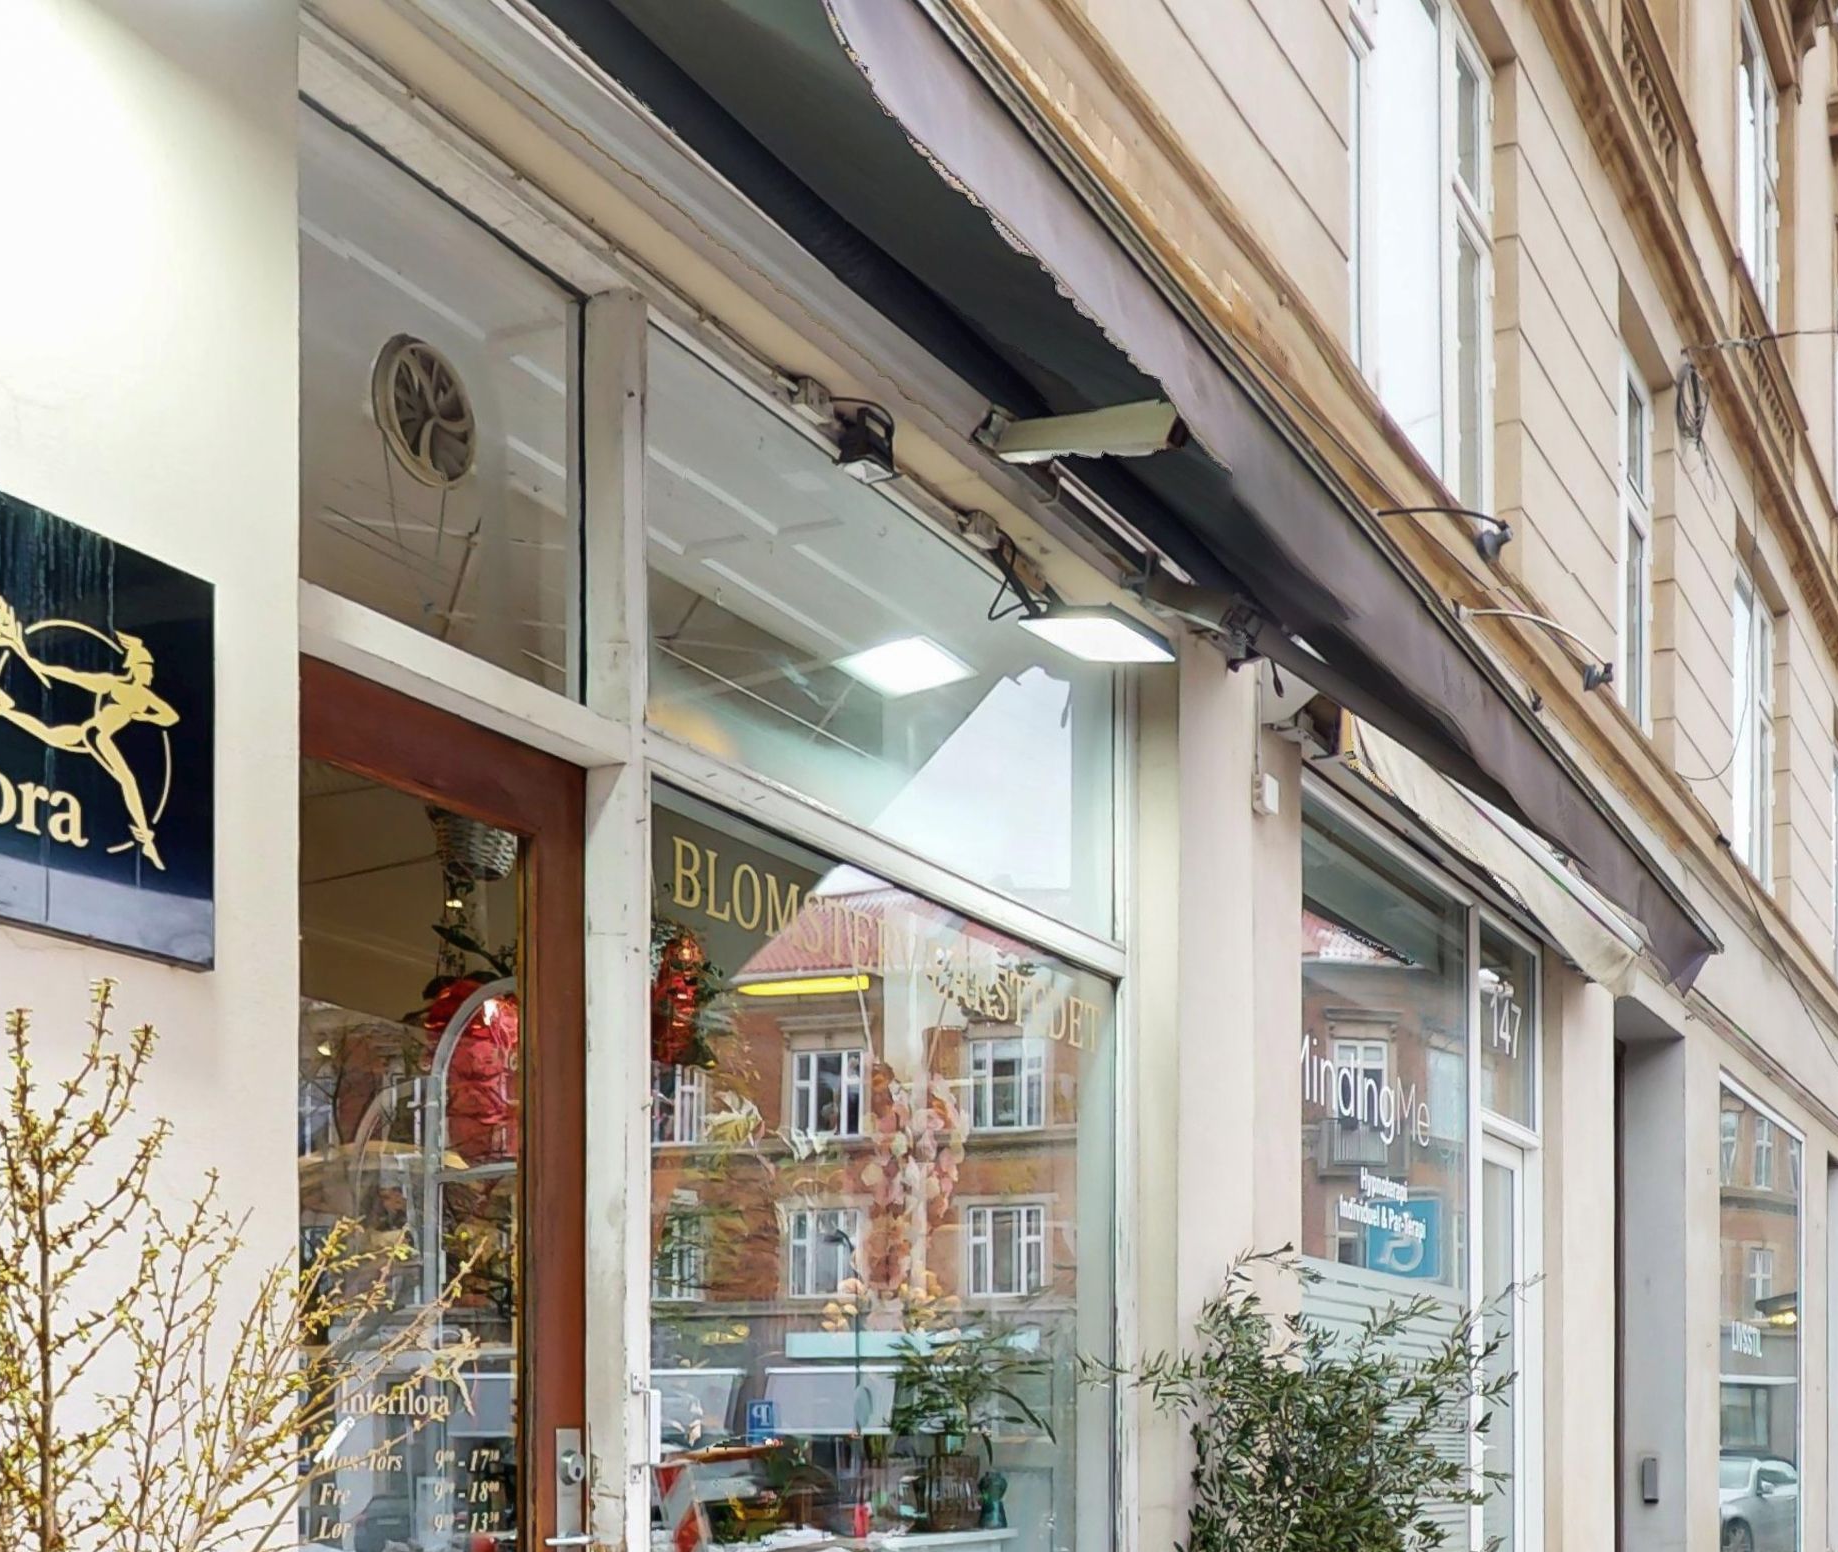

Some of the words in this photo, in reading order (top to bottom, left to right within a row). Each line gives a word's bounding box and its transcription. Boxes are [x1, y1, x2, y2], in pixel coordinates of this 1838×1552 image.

[1491, 990, 1522, 1059] 147
[1360, 1166, 1408, 1207] Hypnoterapi
[1339, 1193, 1380, 1228] Individuel
[1381, 1206, 1388, 1229] &
[342, 1376, 450, 1416] Interflora
